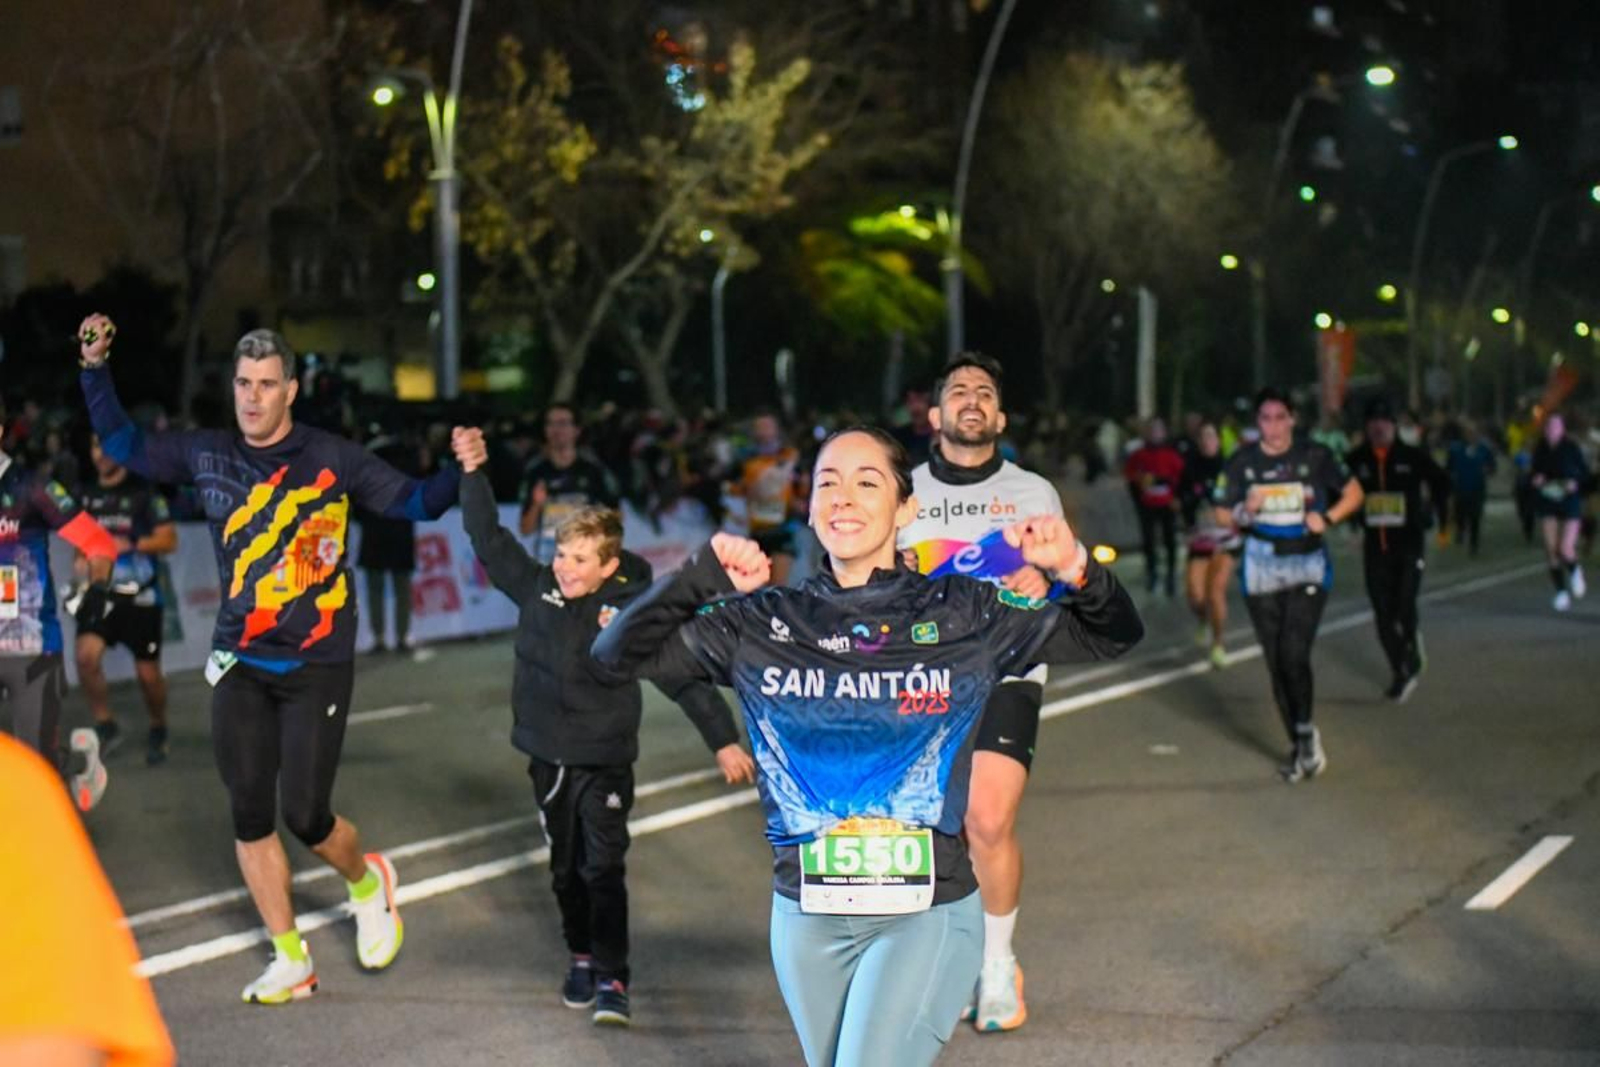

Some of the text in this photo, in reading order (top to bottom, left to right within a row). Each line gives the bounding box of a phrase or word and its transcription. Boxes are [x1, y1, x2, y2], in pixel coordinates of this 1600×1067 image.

[760, 663, 950, 699] SAN ANTÓN
[897, 691, 951, 714] 2025
[810, 836, 922, 875] 1550
